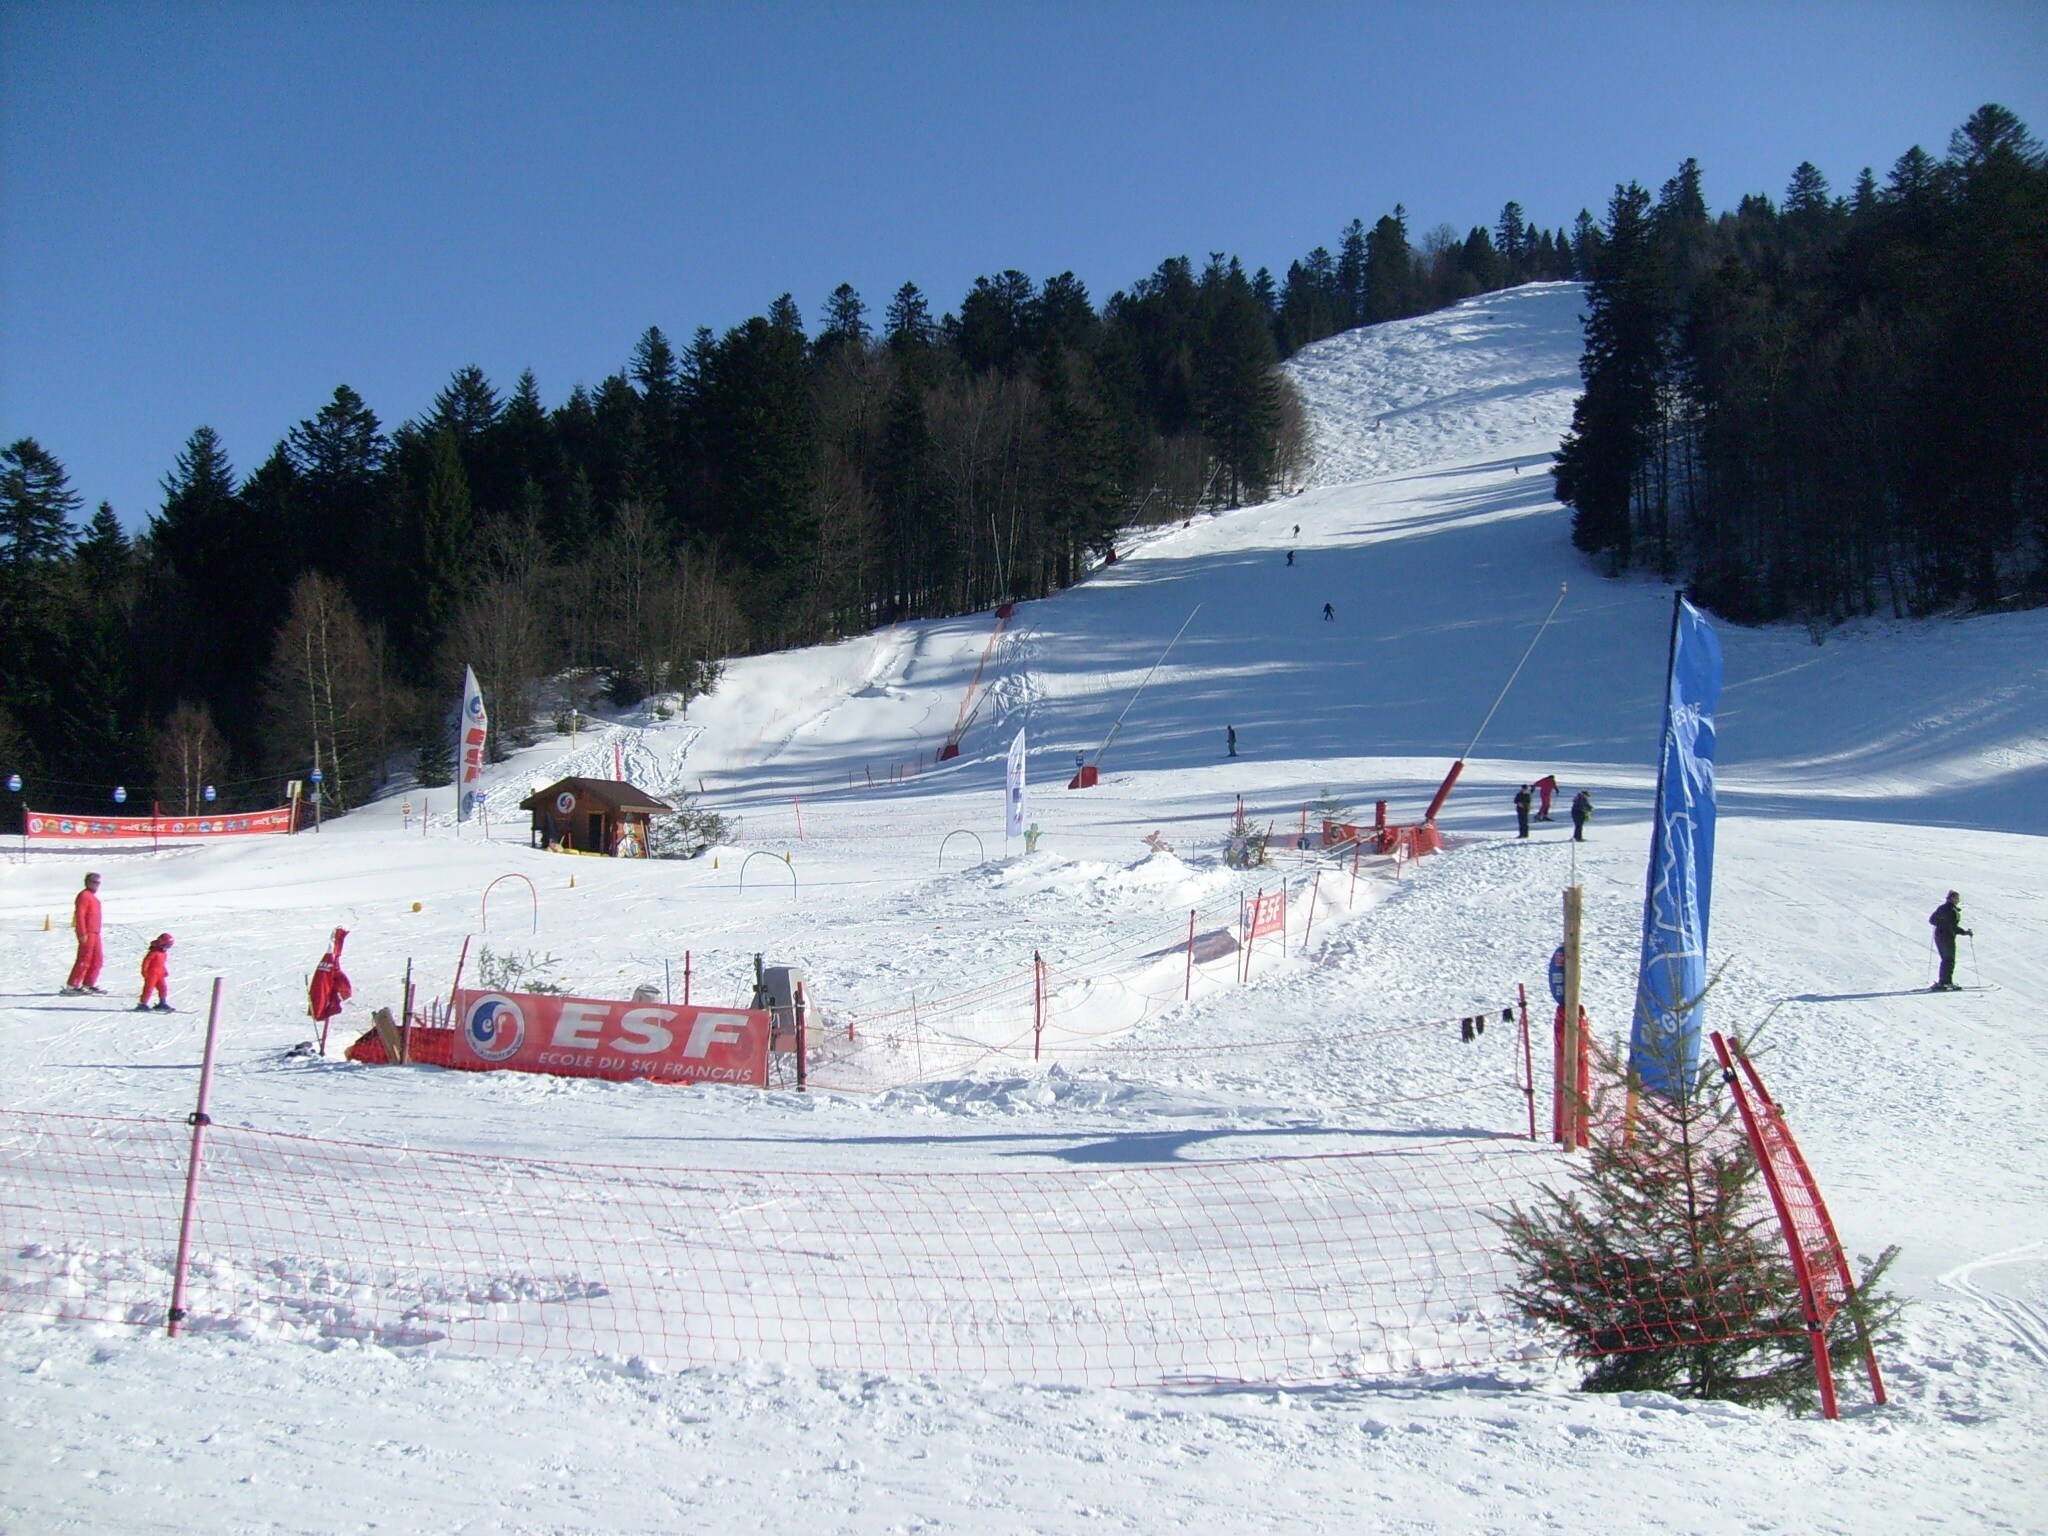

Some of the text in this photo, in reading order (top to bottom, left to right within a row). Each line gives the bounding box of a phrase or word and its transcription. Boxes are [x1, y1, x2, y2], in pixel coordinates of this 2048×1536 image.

[551, 1002, 750, 1059] ESF
[538, 1052, 595, 1068] ECOLE
[598, 1057, 626, 1070] DU
[630, 1059, 656, 1073] SKI
